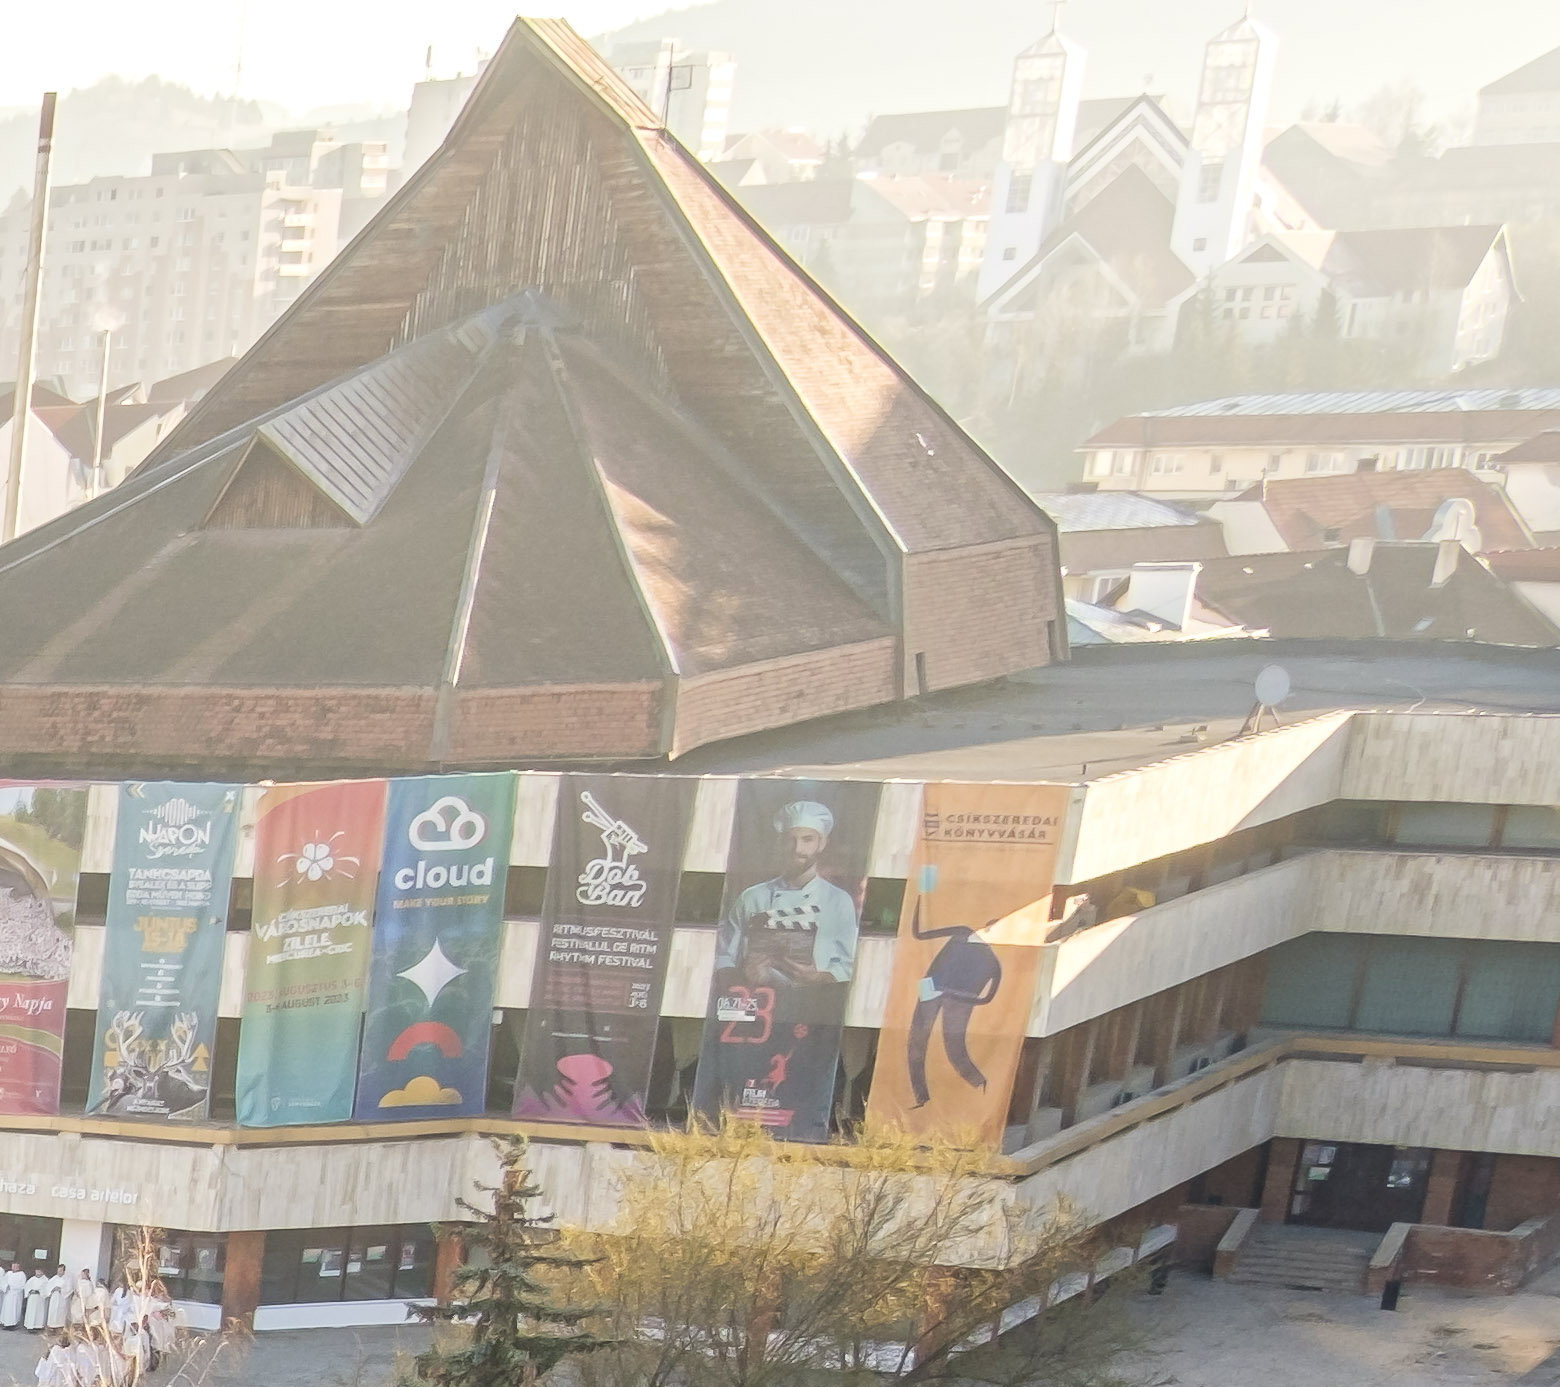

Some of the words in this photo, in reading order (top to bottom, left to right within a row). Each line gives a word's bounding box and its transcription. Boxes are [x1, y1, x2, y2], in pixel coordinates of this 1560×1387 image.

[394, 857, 495, 890] cloud
[578, 859, 640, 885] Dob
[576, 881, 647, 908] Ban
[597, 954, 654, 969] FESTIVAL
[13, 992, 53, 1016] Napja
